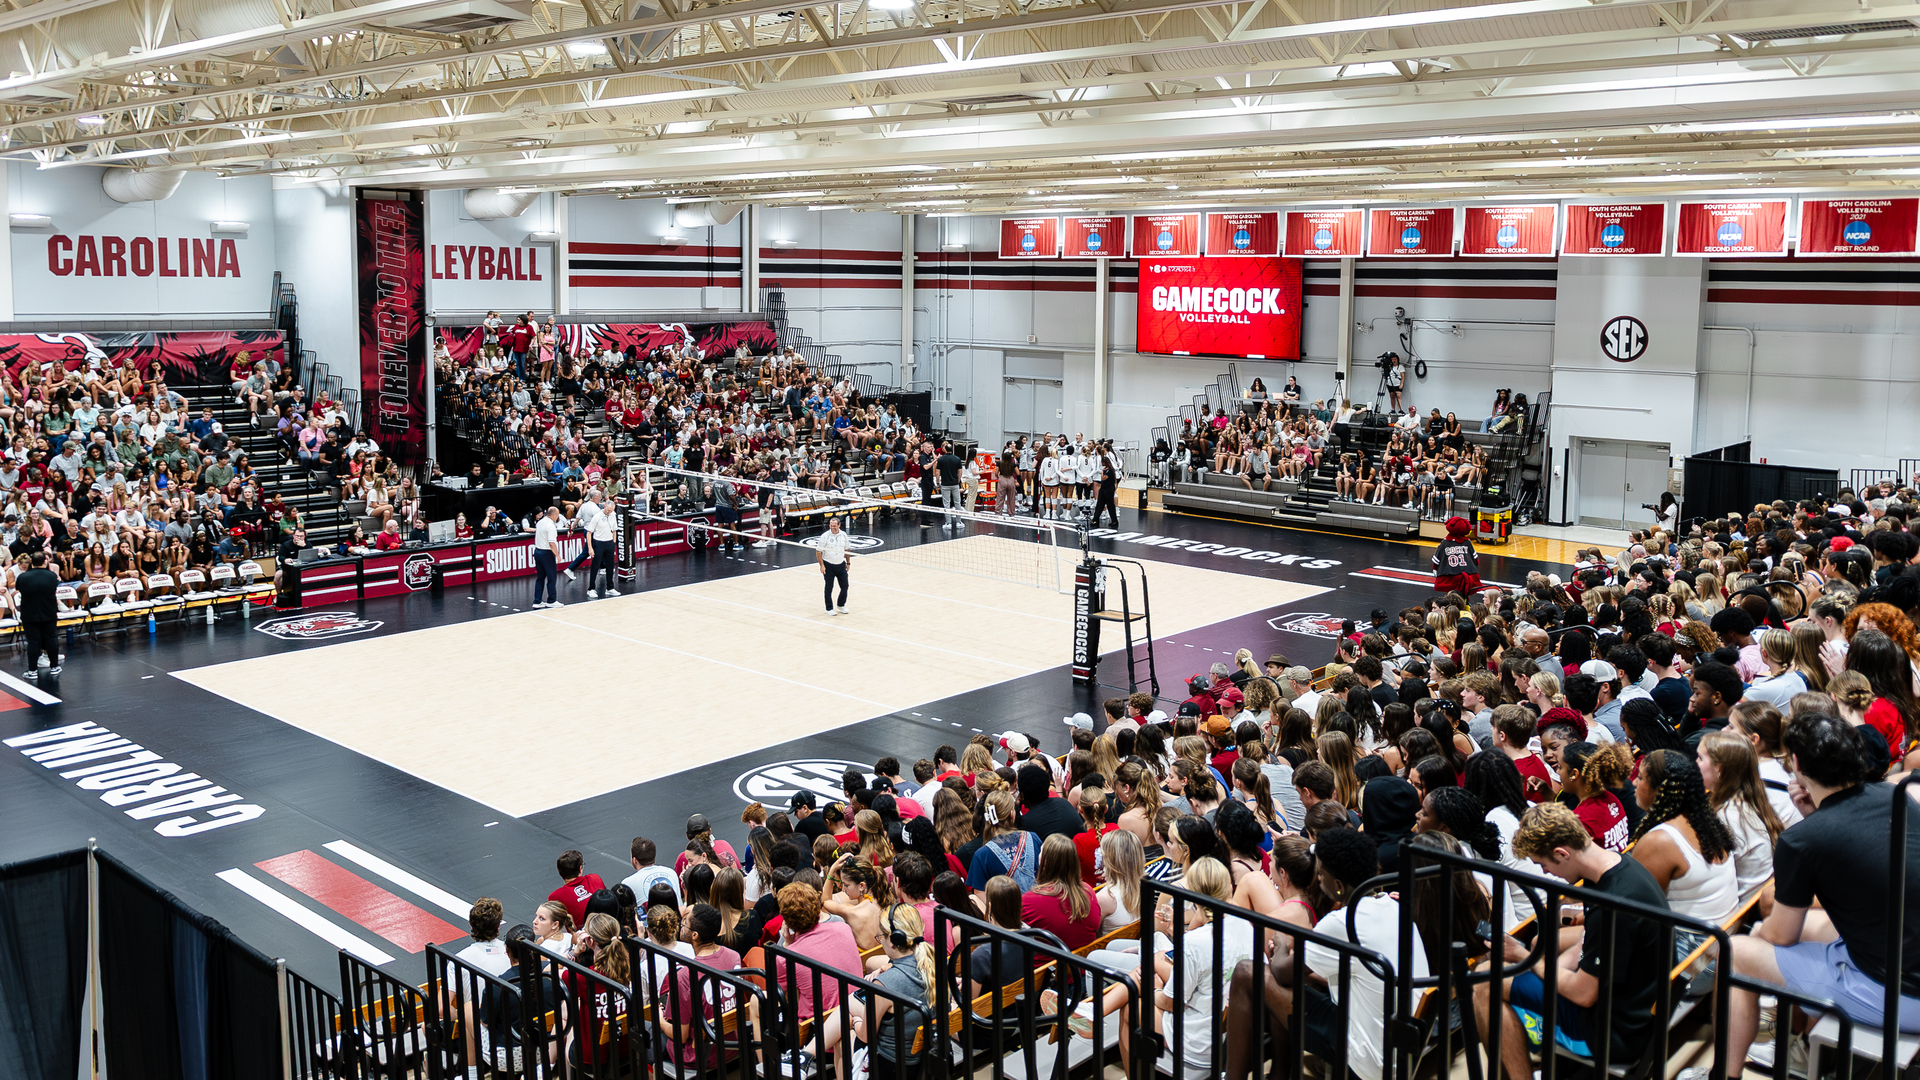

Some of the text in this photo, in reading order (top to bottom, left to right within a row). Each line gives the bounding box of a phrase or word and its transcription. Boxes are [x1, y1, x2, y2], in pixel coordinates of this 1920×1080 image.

[1498, 235, 1518, 243] NCAA
[1719, 232, 1742, 241] NCAA
[1846, 232, 1871, 240] NCAA
[47, 234, 241, 278] CAROLINA
[431, 244, 542, 281] LEYBALL
[375, 201, 410, 429] FOREVER TO THEE
[1152, 286, 1286, 314] GAMECOCK.
[1179, 313, 1251, 324] VOLLEYBALL
[1604, 319, 1645, 359] SEC
[486, 537, 583, 574] SOUTH CLINA
[617, 513, 625, 561] CAROLINA
[1088, 528, 1342, 569] GAMECOCKS
[1447, 554, 1468, 568] 01
[1075, 588, 1090, 664] GAMECOCKS
[2, 720, 267, 837] CAROLINA
